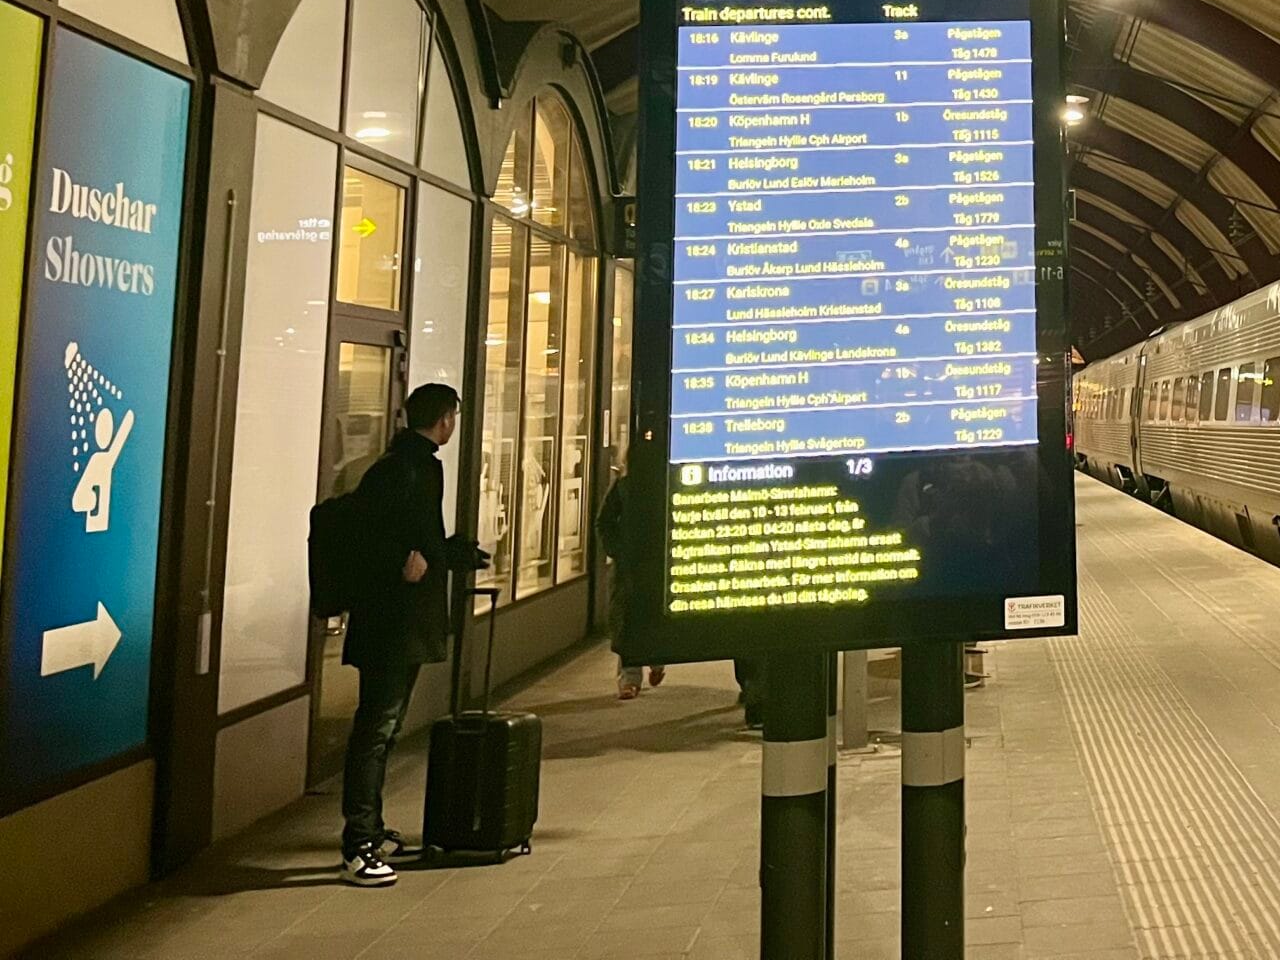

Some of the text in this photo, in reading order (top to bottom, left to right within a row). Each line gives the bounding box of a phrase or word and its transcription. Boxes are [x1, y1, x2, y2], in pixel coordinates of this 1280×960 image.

[682, 4, 918, 23] Train departures cont. Track
[689, 33, 719, 44] 18:16
[730, 31, 779, 45] Kävlinge
[947, 28, 1002, 40] Pågatågen
[952, 48, 971, 60] Tåg
[689, 68, 1002, 87] 18:19 Kävlinge 11 Pågatågen
[952, 89, 970, 101] Tåg
[689, 117, 717, 128] 18:20
[729, 115, 798, 129] Köpenhamn
[800, 114, 810, 125] H
[943, 108, 1008, 121] Öresundståg
[952, 129, 972, 142] Tåg
[688, 160, 716, 170] 18:21
[728, 157, 799, 171] Helsingborg
[949, 150, 1003, 164] Pågatågen
[953, 171, 972, 184] Tåg
[49, 167, 157, 234] Duschar
[728, 200, 762, 212] Ystad
[949, 192, 1004, 206] Pågatågen
[953, 213, 972, 225] Tåg
[727, 241, 798, 255] Kristianstad
[950, 233, 1004, 247] Pågatågen
[44, 235, 154, 296] Showers
[954, 256, 973, 268] Tåg
[686, 289, 715, 300] 18:27
[727, 286, 790, 299] Karlskrona
[944, 276, 1009, 289] Öresundståg
[954, 299, 973, 311] Tåg
[726, 329, 797, 343] Helsingborg
[945, 319, 1010, 332] Öresundståg
[954, 342, 973, 354] Tåg
[725, 374, 796, 388] Köpenhamn
[798, 372, 808, 384] H
[945, 364, 1011, 377] Öresundståg
[954, 386, 974, 398] Tåg
[725, 418, 785, 432] Trelleborg
[951, 407, 1006, 421] Pågatågen
[954, 429, 974, 442] Tåg
[708, 458, 873, 482] Information 1/3
